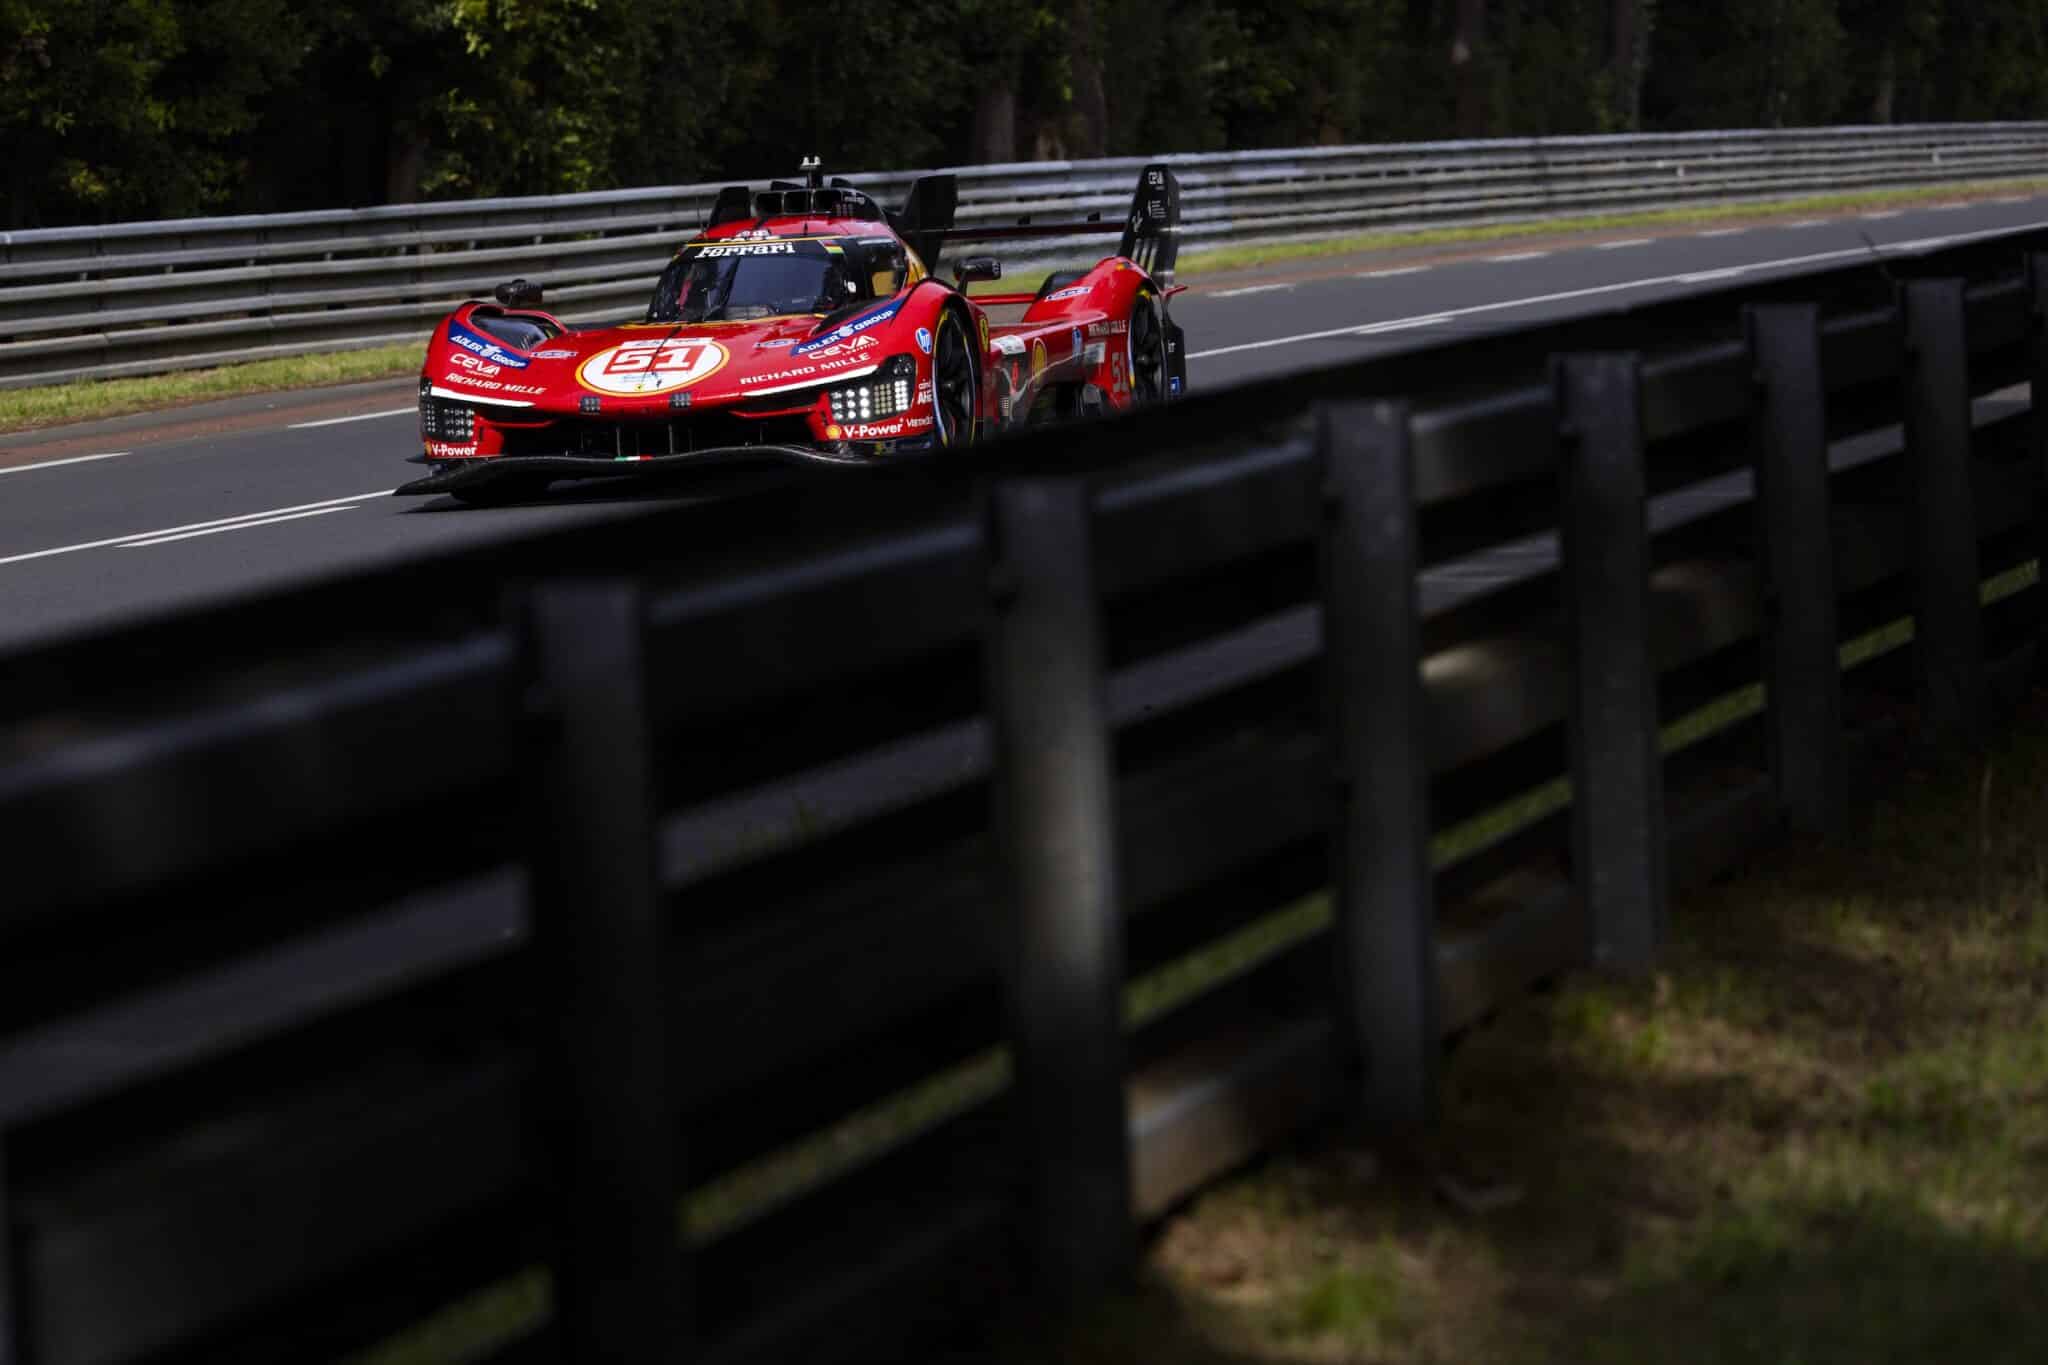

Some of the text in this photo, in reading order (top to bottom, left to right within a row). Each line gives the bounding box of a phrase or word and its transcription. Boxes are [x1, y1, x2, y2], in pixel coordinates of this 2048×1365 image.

[694, 242, 796, 259] Ferrari
[798, 334, 840, 354] ADLER
[854, 310, 894, 330] GROUP
[450, 335, 482, 352] ADLER
[609, 347, 691, 371] 51
[739, 353, 871, 385] RICHARD MILLE
[445, 373, 501, 390] RICHARD
[502, 384, 547, 395] MILLE
[843, 423, 903, 437] V-Power
[431, 443, 478, 457] V-Power
